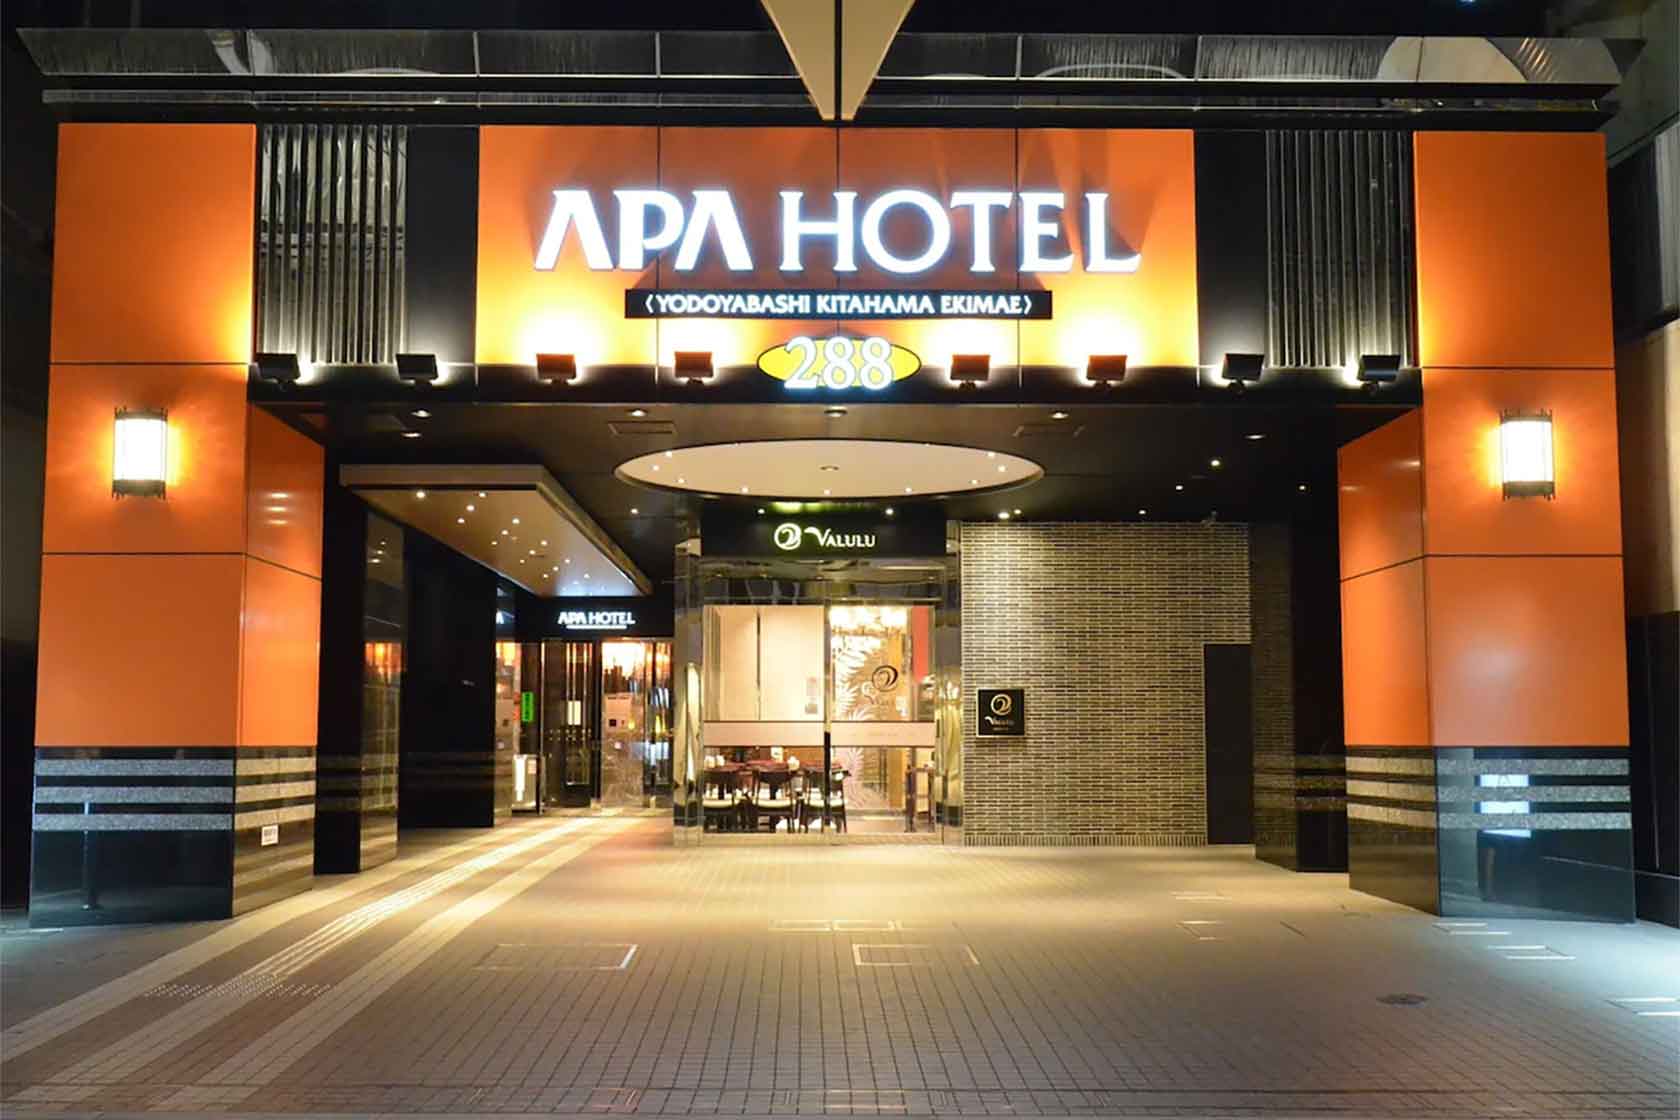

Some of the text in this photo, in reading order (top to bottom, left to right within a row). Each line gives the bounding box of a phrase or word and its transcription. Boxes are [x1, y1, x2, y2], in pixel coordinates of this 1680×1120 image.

[534, 189, 1142, 274] APA HOTEL
[816, 294, 936, 315] KITAHAMA
[783, 336, 894, 390] 288
[558, 611, 636, 625] APA HOTEL
